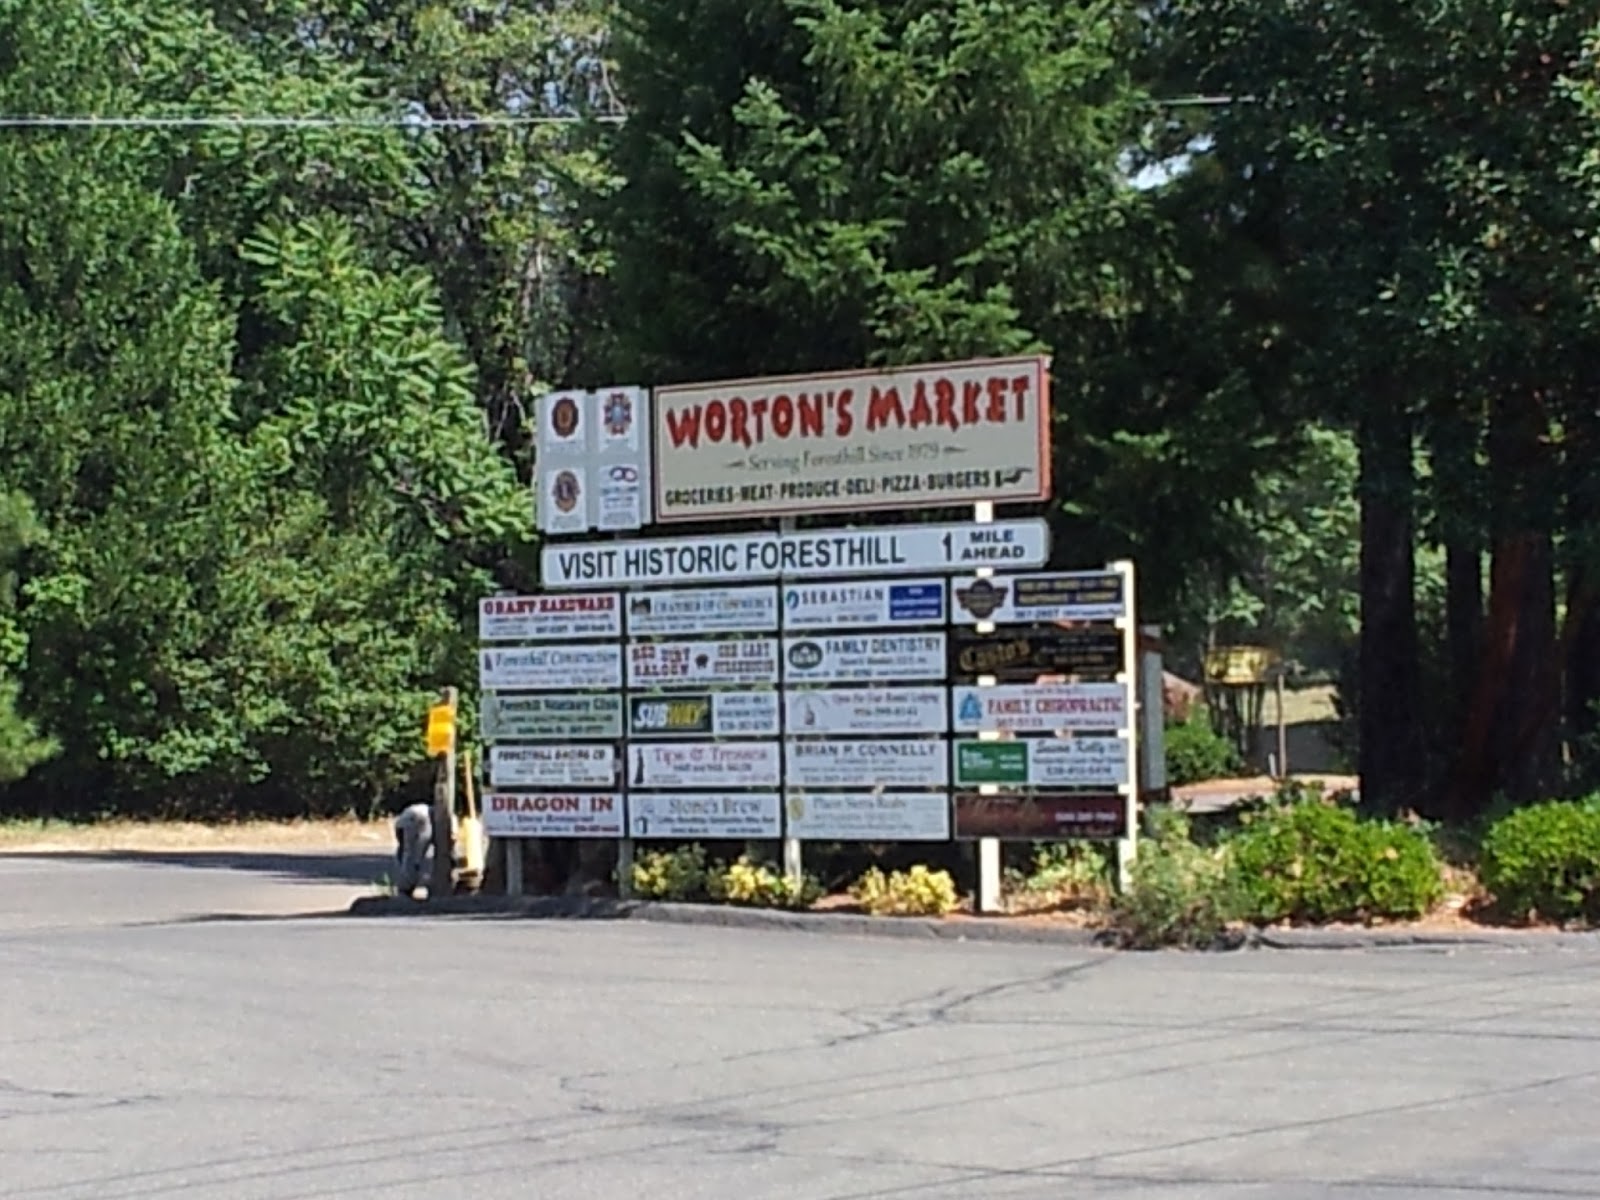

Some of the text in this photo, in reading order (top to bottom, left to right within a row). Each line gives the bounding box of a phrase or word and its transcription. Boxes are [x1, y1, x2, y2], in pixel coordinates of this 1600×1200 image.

[666, 374, 1030, 449] WORTON'S MARKET
[749, 455, 799, 475] Serving
[803, 446, 865, 467] Foresthill
[868, 448, 903, 465] Since
[665, 486, 733, 507] GROCERIES
[781, 479, 839, 498] PRODUCE
[882, 473, 920, 493] PIZZA
[927, 470, 990, 490] BURGERS
[969, 529, 1014, 544] MILE
[559, 531, 952, 579] VISIT HISTORIC FORESTHILL 1
[961, 545, 1025, 560] AHEAD
[801, 587, 884, 605] SEBASTIAN
[825, 636, 940, 654] FAMILY DENTISTRY
[987, 696, 1122, 714] FAMILY CHIROPRACTIC
[633, 701, 709, 728] SUBWAY
[795, 744, 838, 757] BRIAN
[858, 743, 937, 757] CONNELLY
[491, 796, 613, 812] DRAGON IN
